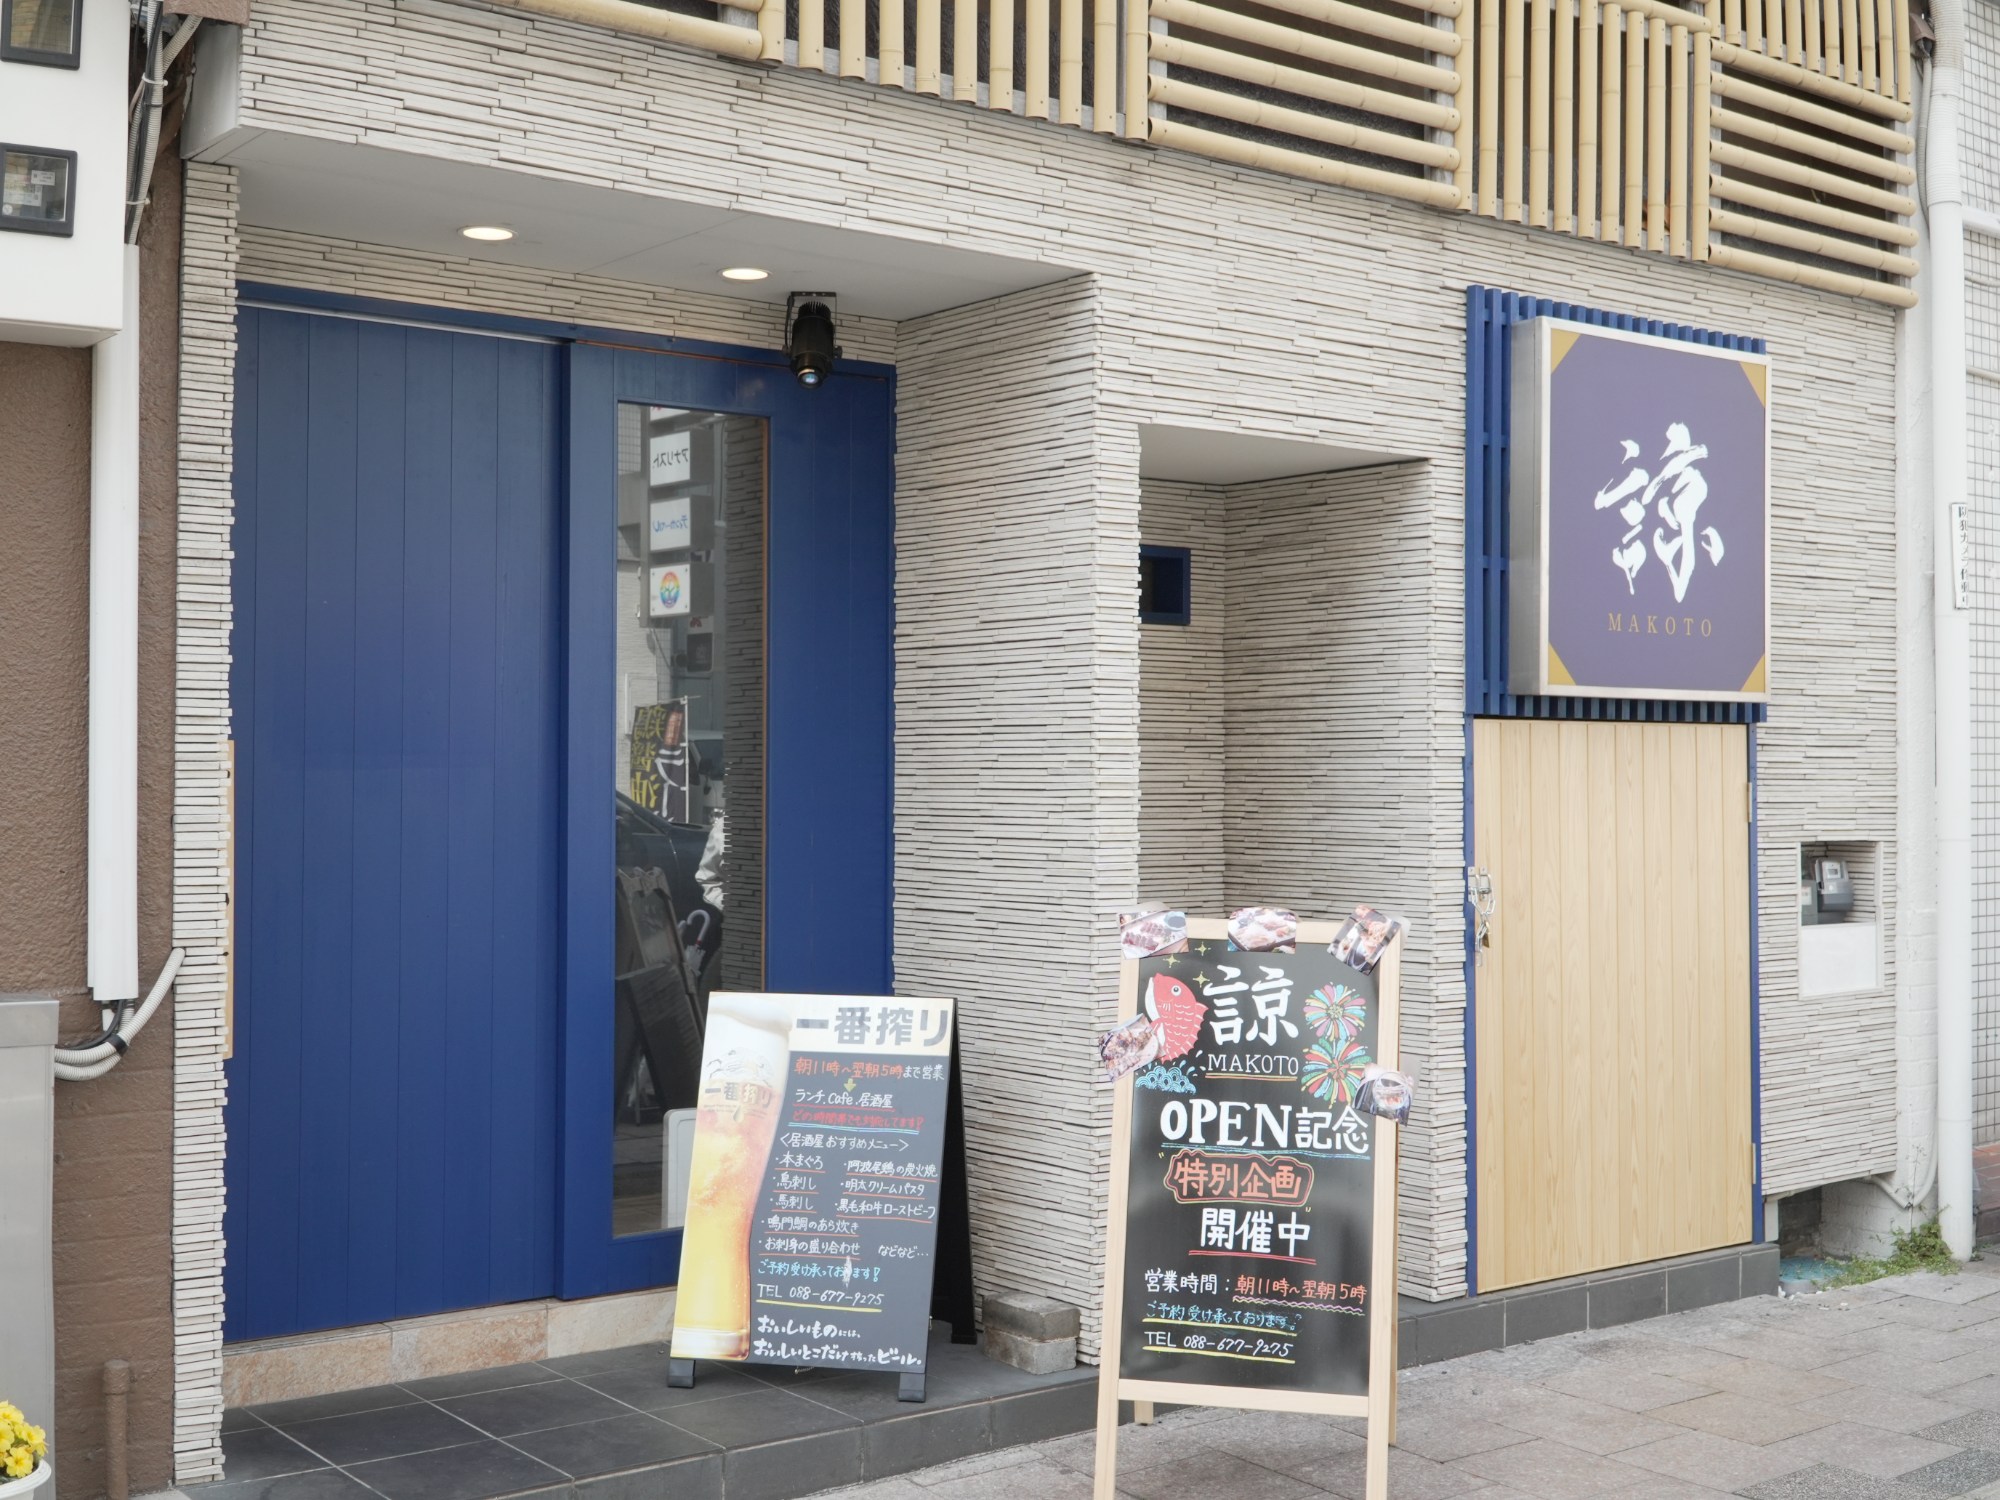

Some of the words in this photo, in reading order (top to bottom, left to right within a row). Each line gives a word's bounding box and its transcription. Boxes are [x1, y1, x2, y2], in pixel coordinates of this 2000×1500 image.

[1594, 422, 1725, 603] 諒
[1608, 612, 1712, 638] MAKOTO
[1202, 964, 1299, 1047] 諒
[796, 1006, 949, 1047] 一番搾り
[1207, 1053, 1299, 1076] MAKOTO
[704, 1081, 773, 1109] 一番搾り
[1160, 1098, 1369, 1154] OPEN記念
[1173, 1158, 1302, 1199] 特別企画
[1199, 1207, 1311, 1257] 開催中
[756, 1283, 783, 1299] TEL
[789, 1286, 885, 1306] 088-677-9275
[1144, 1331, 1177, 1348] TEL
[1184, 1335, 1295, 1358] 088-677-9275
